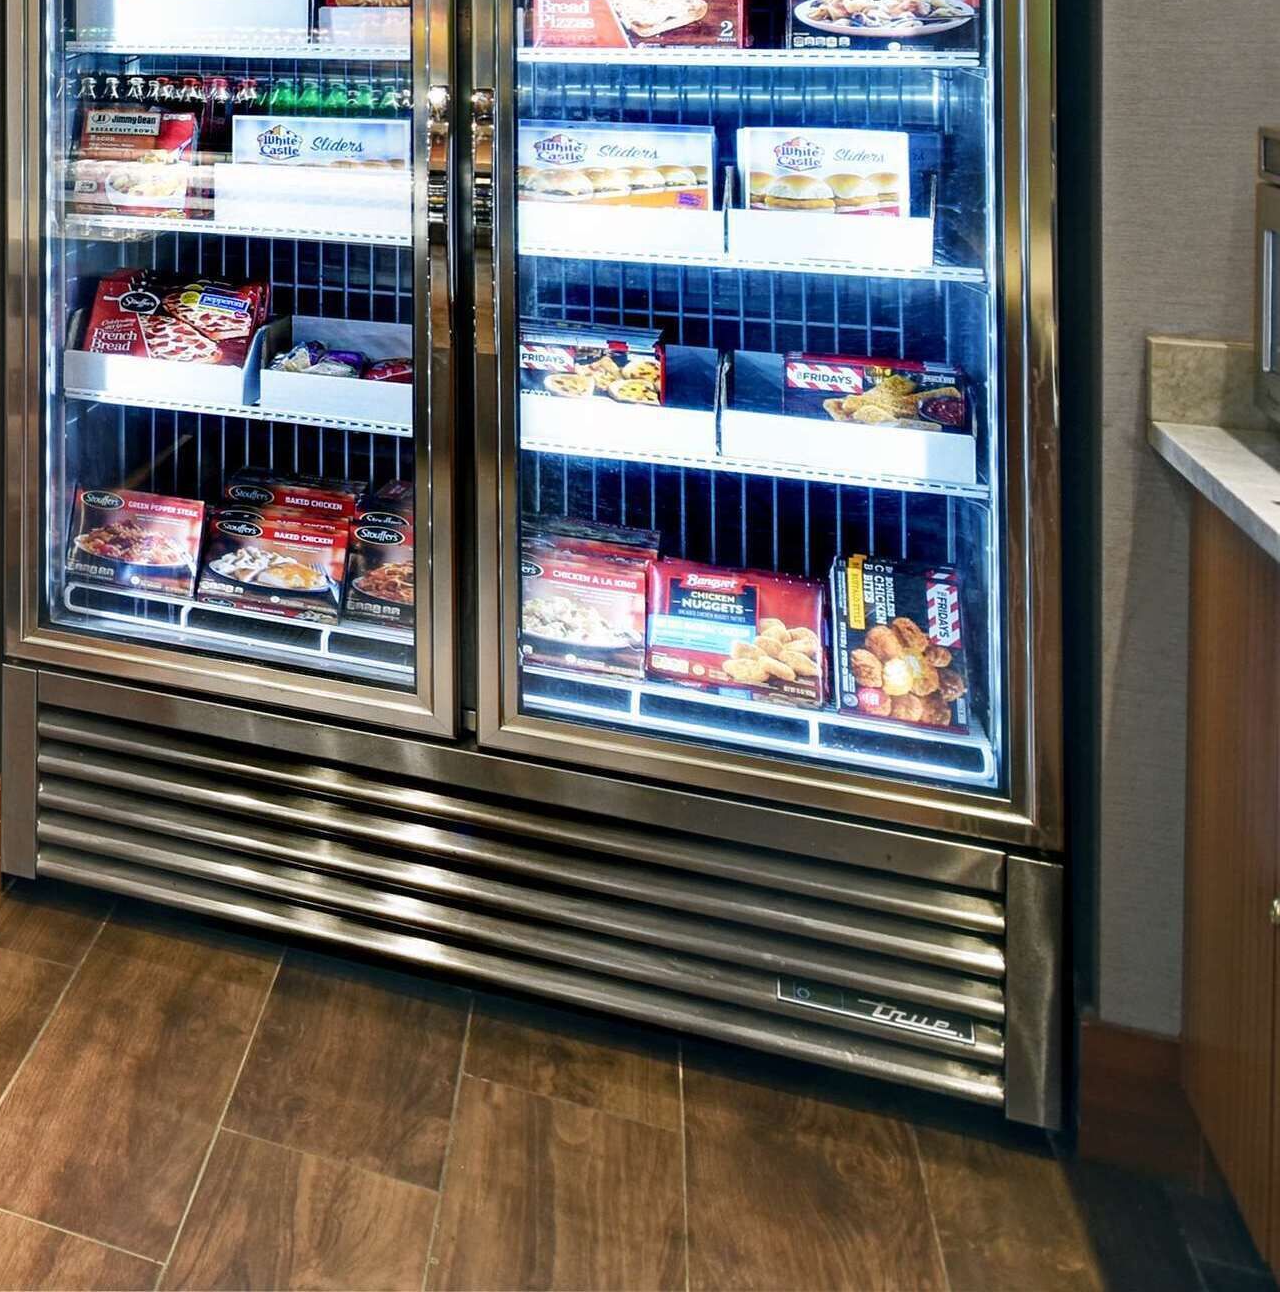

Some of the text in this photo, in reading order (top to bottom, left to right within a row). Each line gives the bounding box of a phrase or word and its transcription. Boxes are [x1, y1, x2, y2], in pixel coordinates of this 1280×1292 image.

[720, 20, 734, 37] 2
[111, 115, 137, 124] Jimmy
[137, 115, 157, 124] Dean
[264, 135, 298, 147] White
[310, 136, 364, 153] Sliders
[260, 145, 300, 156] Castle
[596, 144, 659, 160] Sliders
[781, 145, 820, 157] White
[833, 148, 886, 163] Sliders
[777, 156, 822, 167] Castle
[204, 296, 246, 309] pepperoni
[93, 328, 138, 341] French
[91, 339, 131, 351] Bread
[521, 353, 566, 365] FRIDAYS
[802, 370, 853, 385] FRIDAYS
[86, 493, 120, 508] Stouffer's
[235, 488, 269, 503] Stouffer's
[128, 500, 199, 517] GREEN PEPPER STEAK
[285, 496, 343, 511] BAKED CHICKEN
[223, 522, 258, 536] Stouffer's
[361, 528, 399, 541] Stouffer's
[274, 531, 334, 545] BAKED CHICKEN
[552, 569, 591, 582] CHICKEN
[601, 576, 613, 587] LA
[615, 578, 637, 590] KING
[687, 573, 739, 588] Banquet
[863, 574, 875, 604] BITES
[690, 591, 736, 603] CHICKEN
[874, 575, 888, 625] CHICKEN
[681, 598, 744, 614] NUGGETS
[937, 596, 949, 639] FRIDAYS
